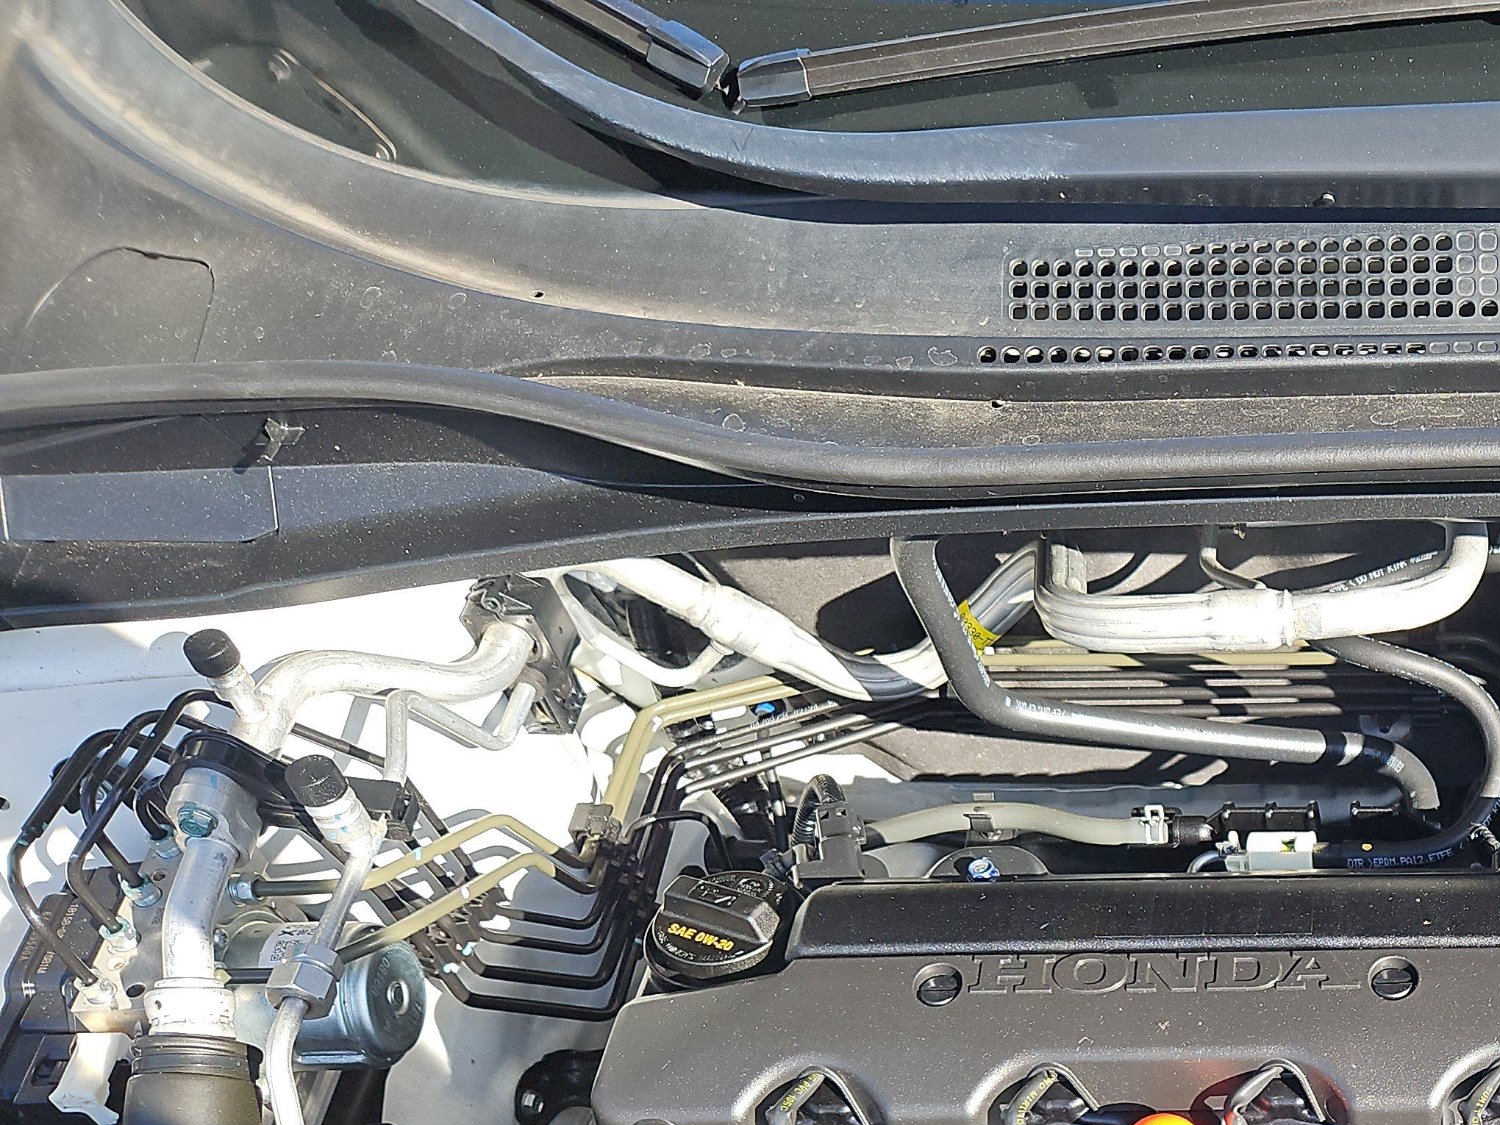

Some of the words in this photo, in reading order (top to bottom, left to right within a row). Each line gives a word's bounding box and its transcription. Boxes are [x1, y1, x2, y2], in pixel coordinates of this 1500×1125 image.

[667, 923, 697, 940] SAE
[694, 931, 735, 952] 0W-20
[967, 951, 1363, 993] HONDA
